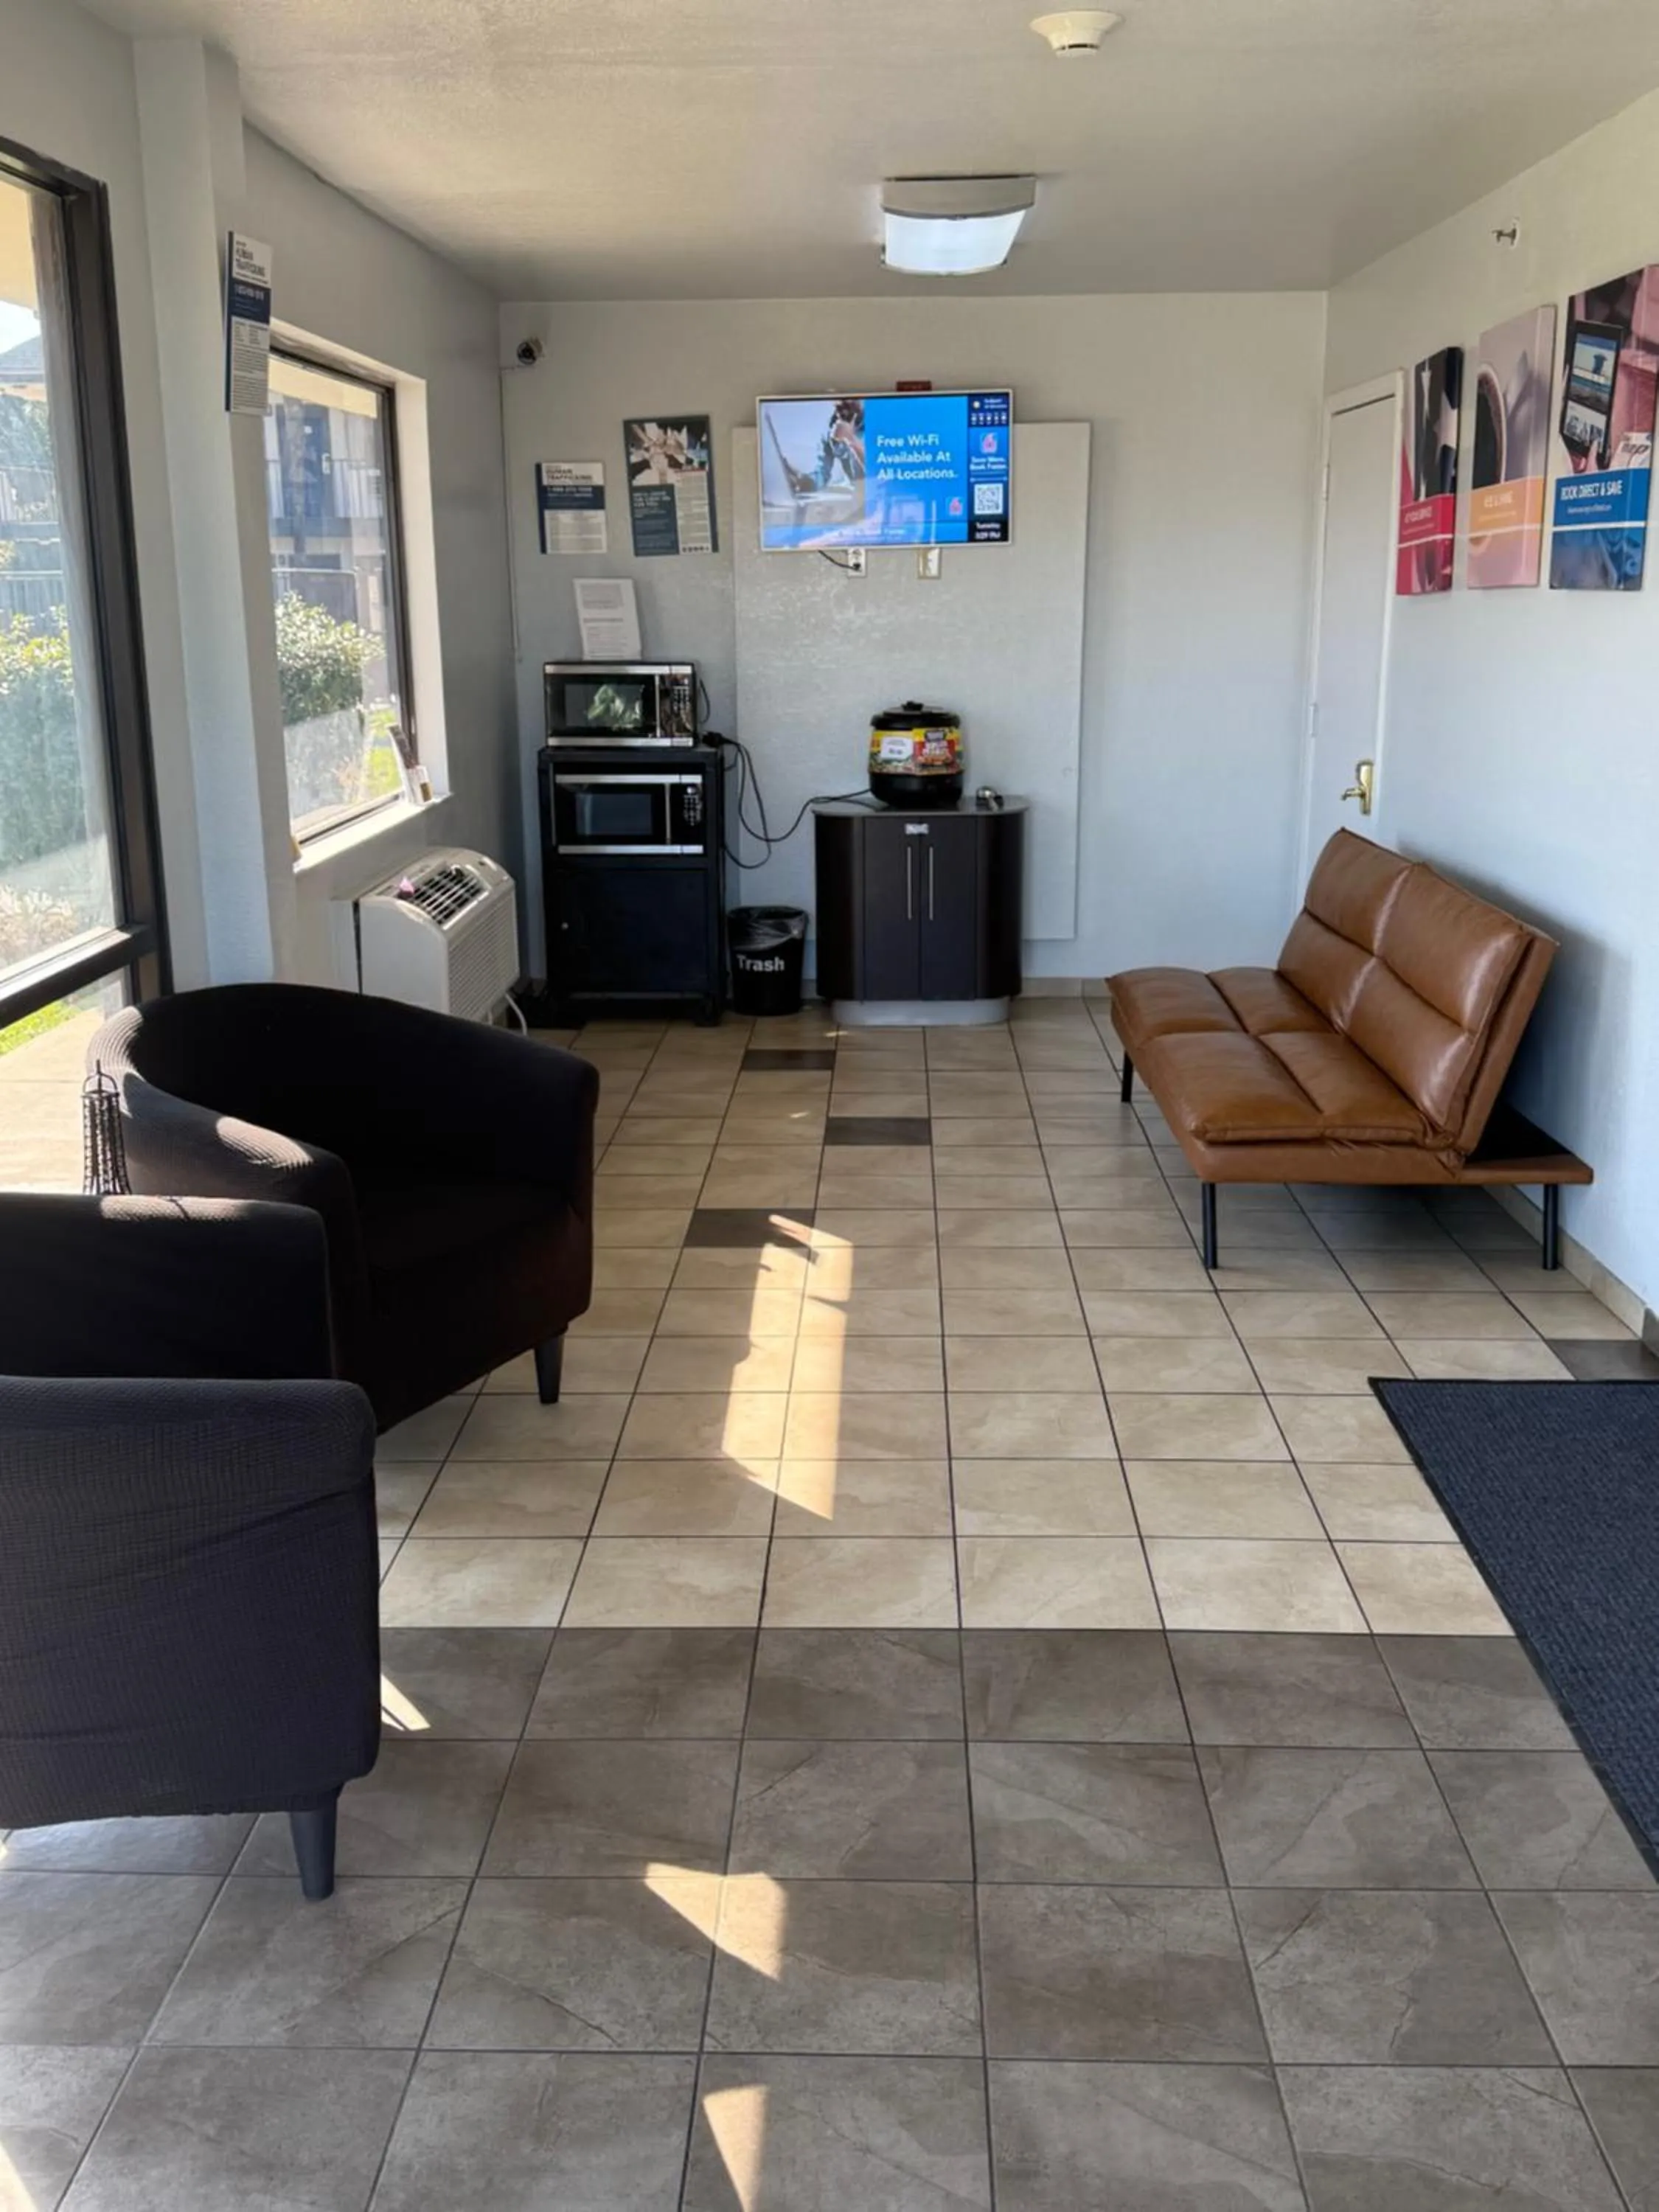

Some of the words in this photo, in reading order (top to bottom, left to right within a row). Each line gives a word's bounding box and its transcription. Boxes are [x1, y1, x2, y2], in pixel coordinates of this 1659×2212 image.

[877, 434, 905, 447] Free
[908, 433, 940, 446] Wi-Fi
[877, 450, 933, 464] Available
[936, 451, 951, 462] At
[877, 467, 894, 480] All
[737, 954, 785, 972] Trash
